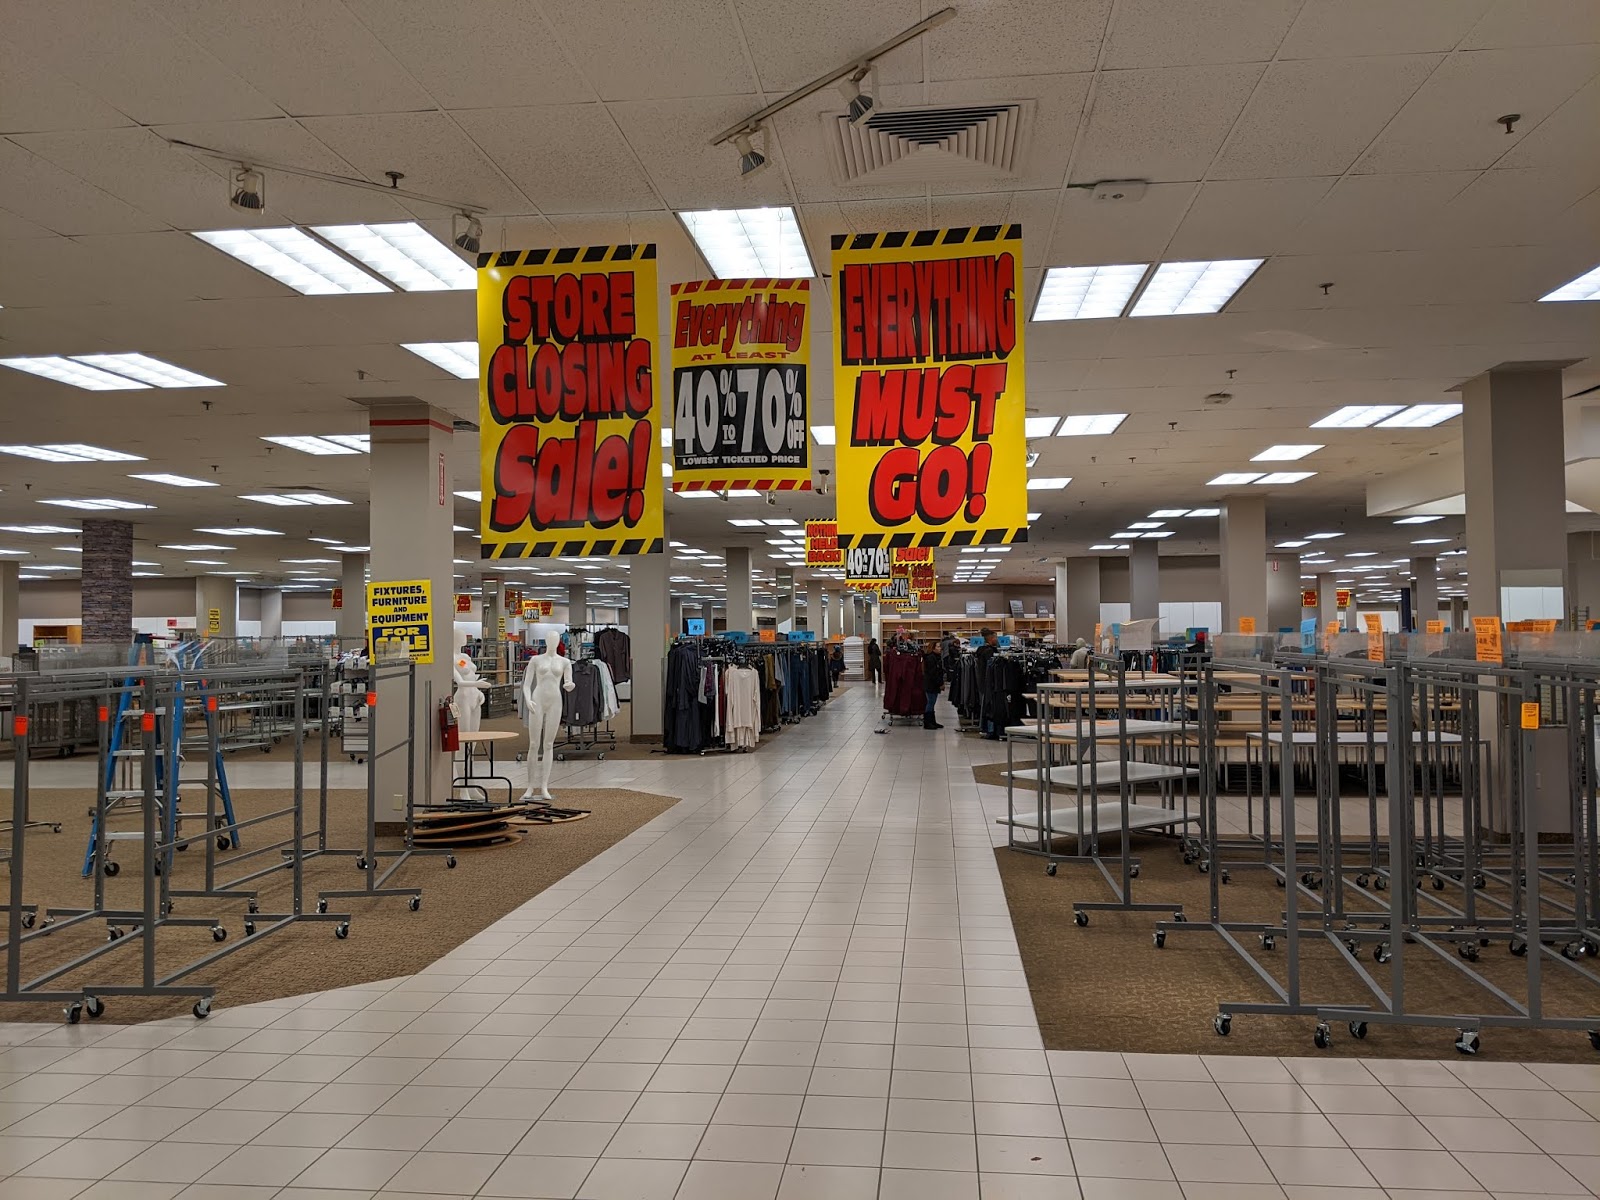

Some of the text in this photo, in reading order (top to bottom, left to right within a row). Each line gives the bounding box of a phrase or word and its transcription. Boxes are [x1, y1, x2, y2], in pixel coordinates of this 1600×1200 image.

[503, 271, 636, 345] STORE
[674, 293, 805, 353] Everything
[840, 252, 1016, 366] EVERYTHING
[488, 338, 652, 425] CLOSING
[675, 368, 804, 454] 40% TO 70% OFF
[850, 363, 1008, 447] MUST
[489, 419, 652, 532] Sale!
[682, 455, 800, 465] LOWEST TICKETED PRICE
[869, 443, 992, 527] GO!
[807, 524, 838, 537] NOTHIN
[808, 550, 841, 562] BACK!
[371, 613, 428, 624] EQUIPMENT
[372, 596, 427, 606] FURNITURE
[374, 585, 425, 596] FIXTURES,
[381, 627, 420, 637] FOR
